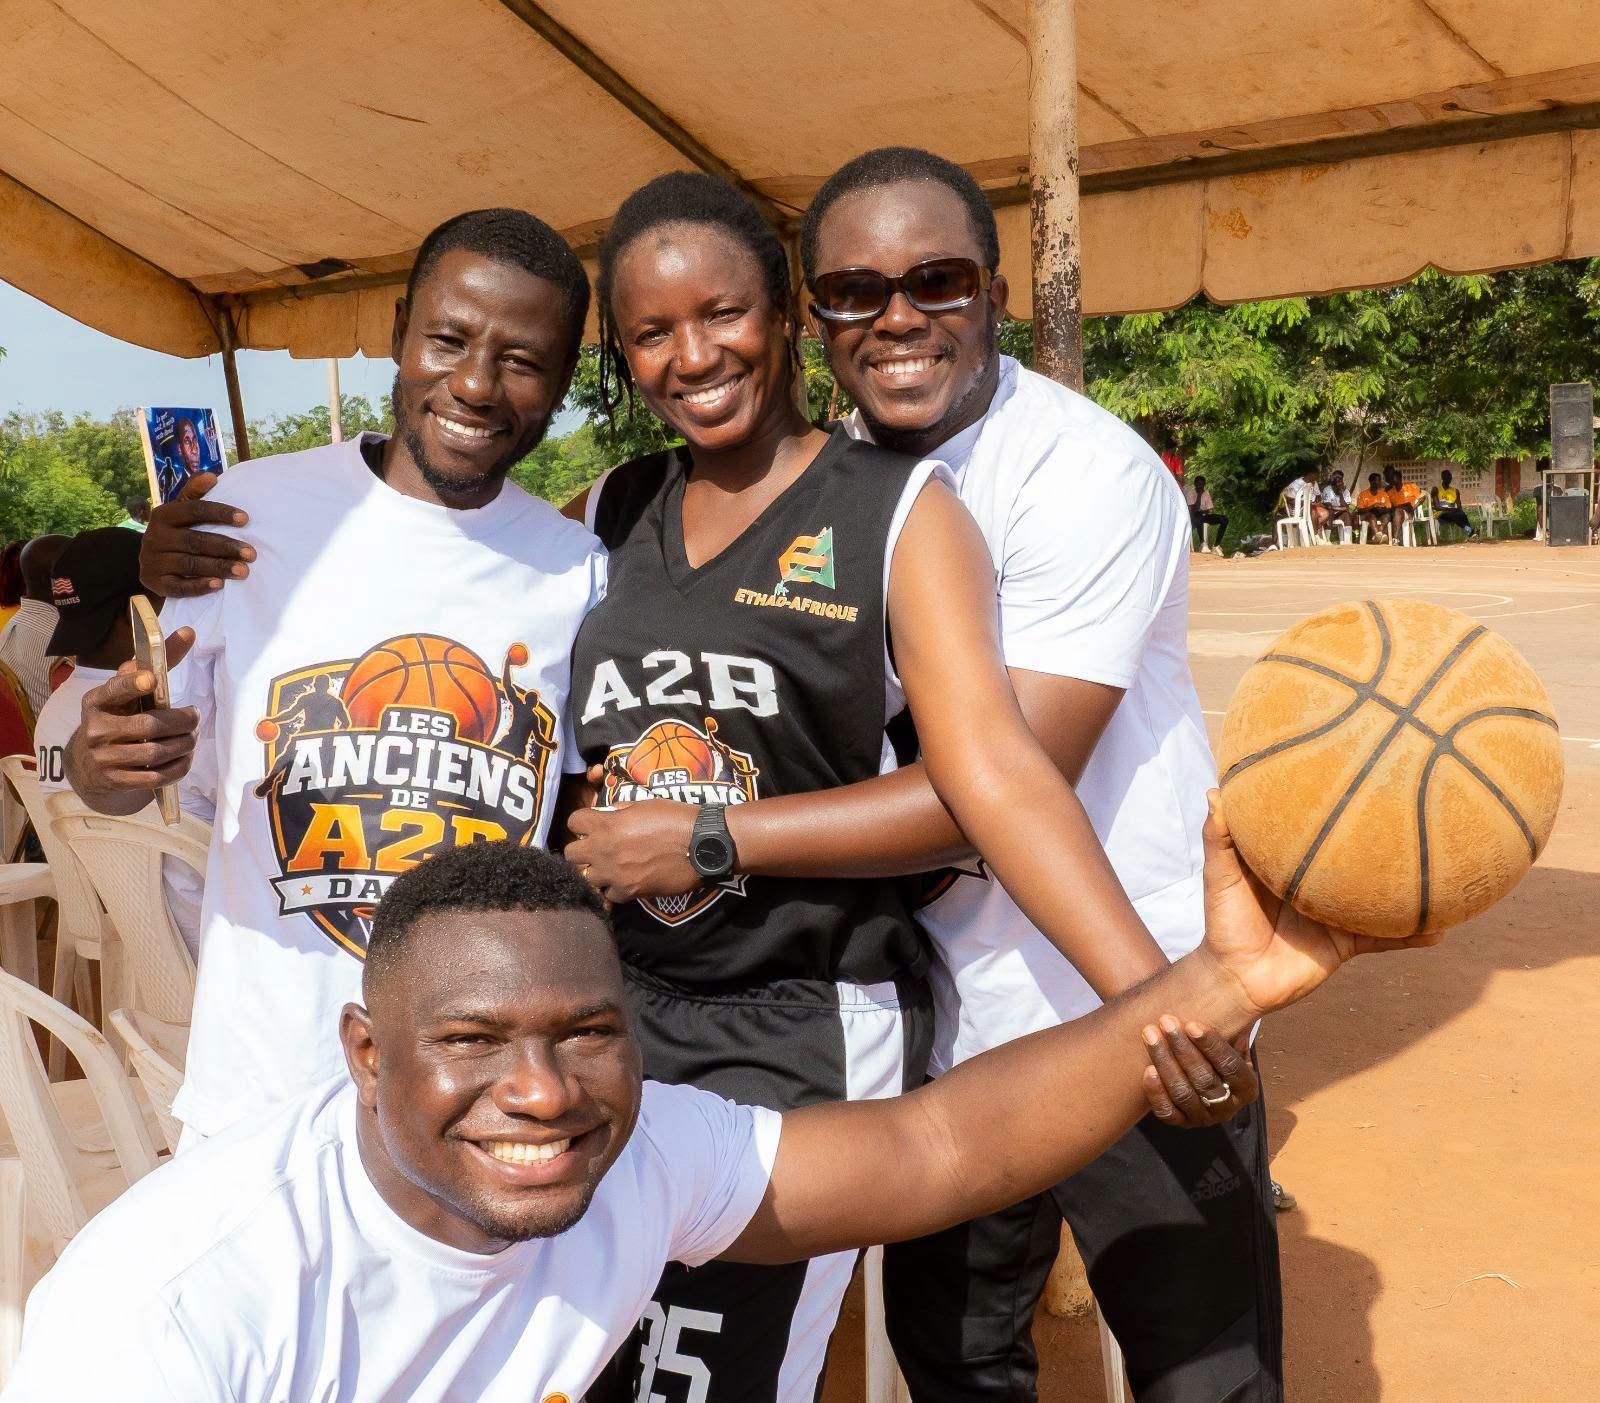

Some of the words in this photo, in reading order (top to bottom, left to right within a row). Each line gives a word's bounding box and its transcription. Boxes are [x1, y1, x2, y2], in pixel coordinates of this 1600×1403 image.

[581, 650, 779, 726] A2B
[388, 711, 450, 738] LES
[281, 735, 537, 822] ANCIENS
[652, 770, 688, 786] LES
[389, 788, 428, 809] DE
